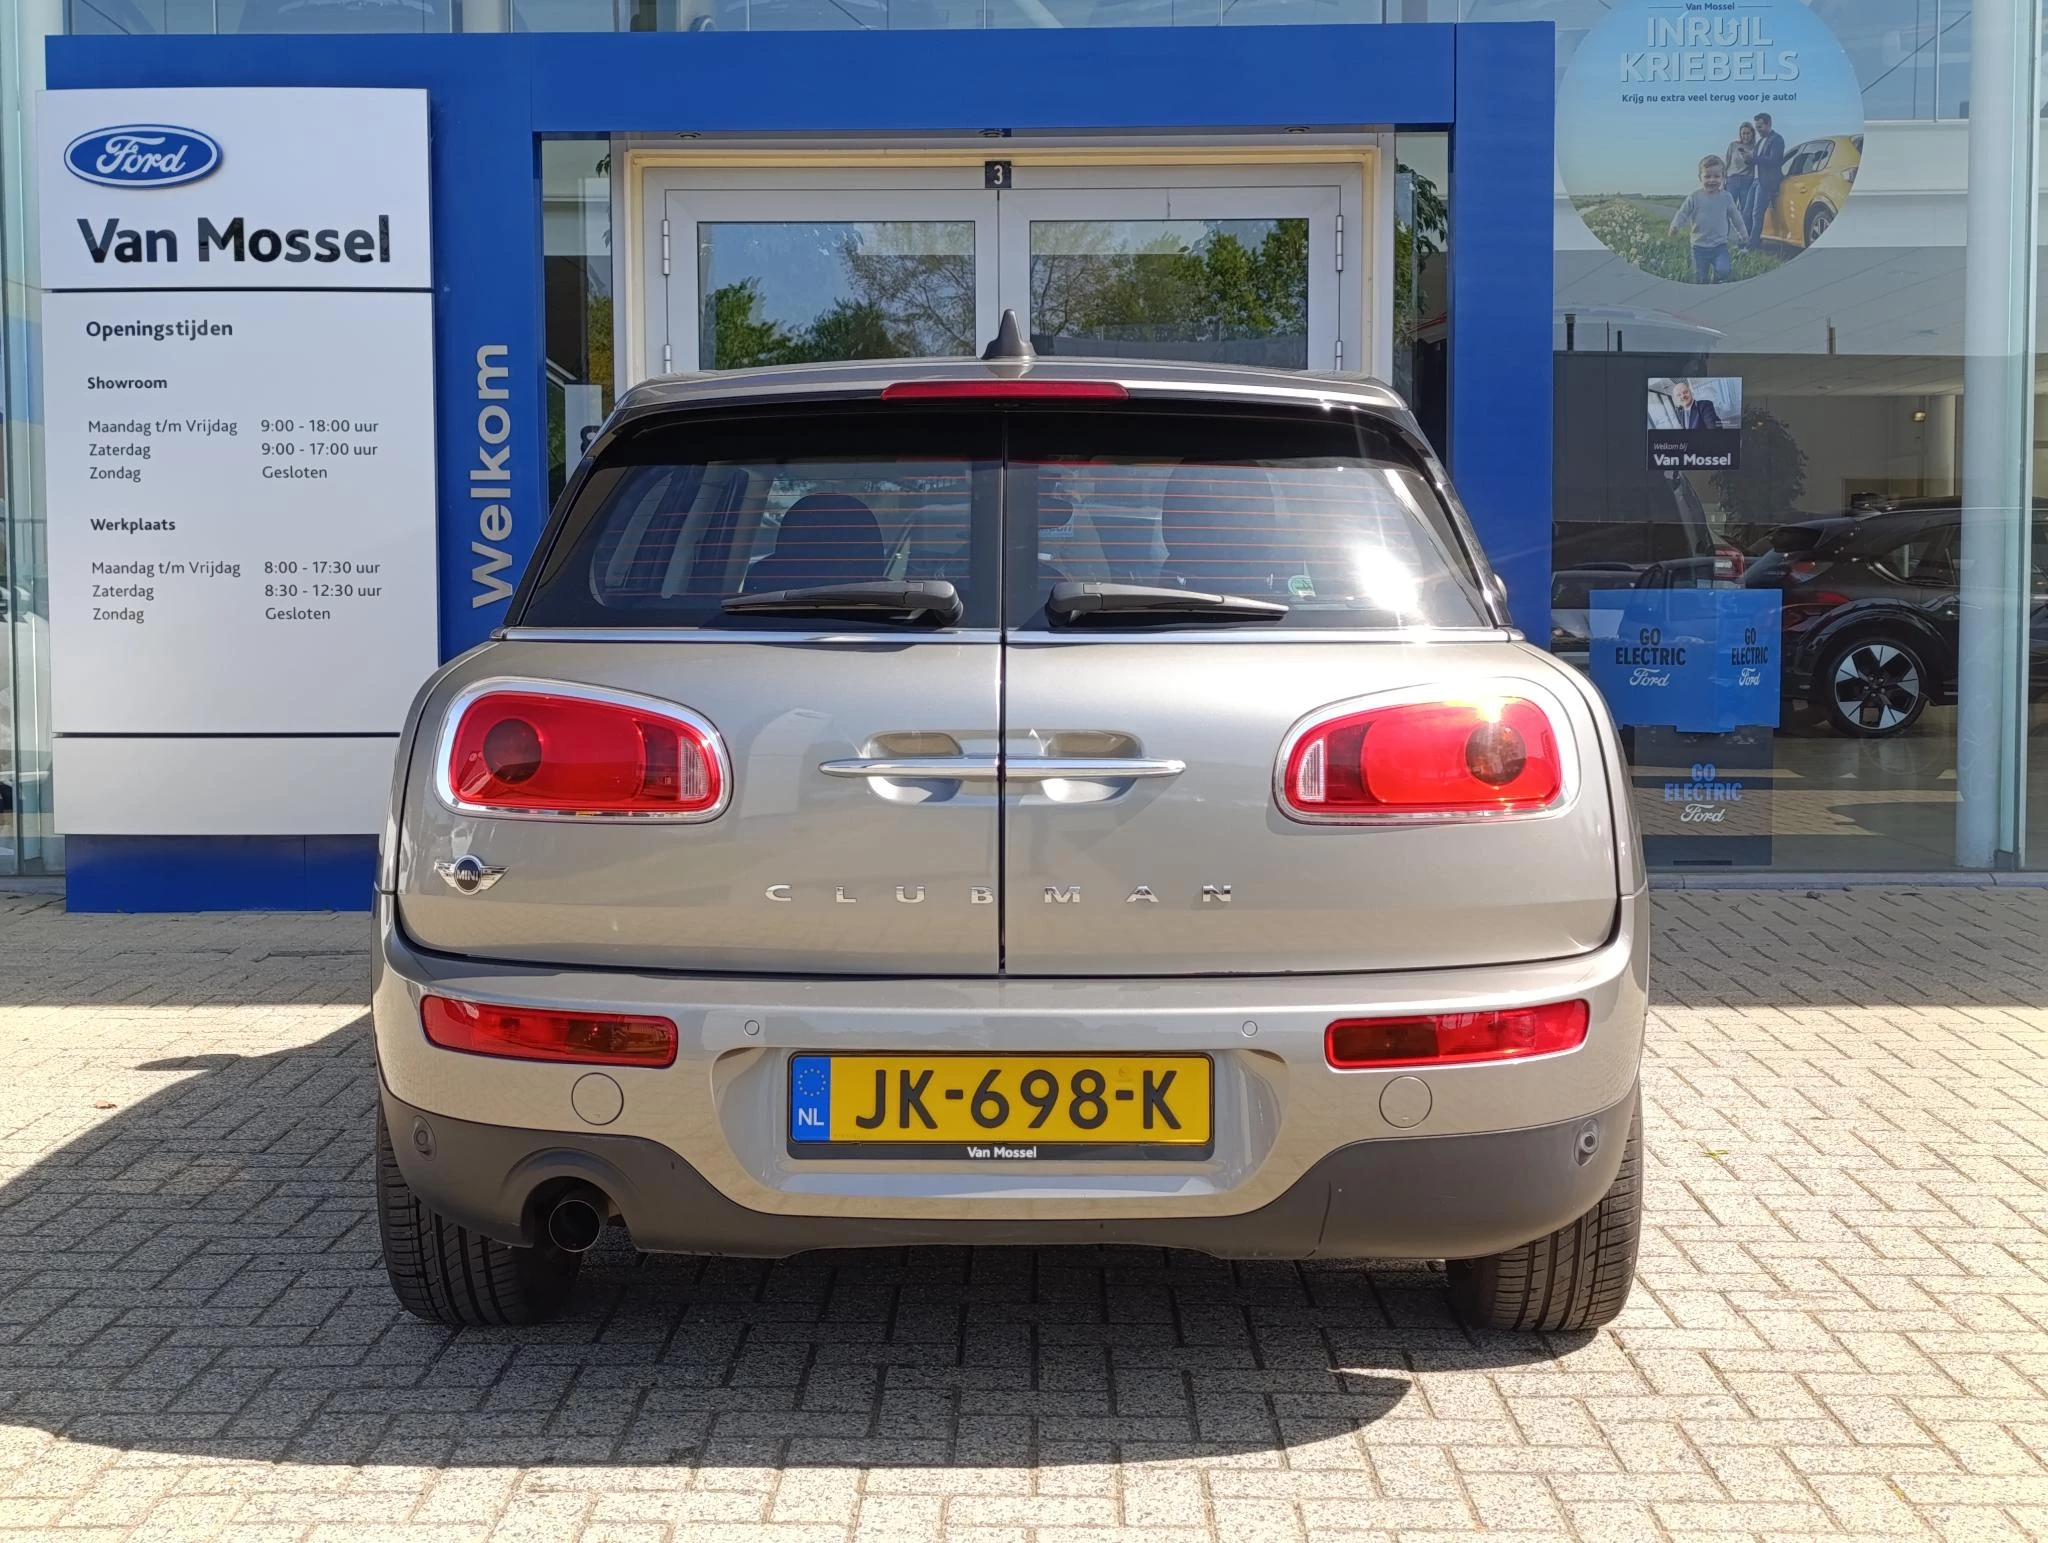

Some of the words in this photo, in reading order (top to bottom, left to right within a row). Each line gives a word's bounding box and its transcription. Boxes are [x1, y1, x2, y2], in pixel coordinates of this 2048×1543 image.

[1686, 2, 1702, 11] Van
[1704, 2, 1735, 11] Mossel
[1648, 16, 1774, 48] INRUIL
[1620, 51, 1800, 83] KRIEBELS
[1622, 94, 1644, 104] Krijg
[1660, 93, 1686, 102] extra
[1688, 93, 1708, 102] veel
[1710, 93, 1736, 103] terug
[1738, 93, 1760, 101] voor
[1761, 92, 1771, 103] je
[1773, 92, 1797, 101] auto!
[96, 135, 188, 175] Ford
[993, 164, 1003, 185] 3
[77, 217, 178, 264] Van
[198, 214, 391, 263] Mossel
[86, 320, 233, 341] Openingstijden
[87, 376, 168, 390] Showroom
[88, 420, 152, 436] Maandag
[155, 420, 182, 433] t/m
[186, 419, 238, 436] Vrijdag
[261, 419, 294, 433] 9:00
[309, 419, 350, 433] 18:00
[354, 422, 379, 433] uur
[89, 443, 151, 459] Zaterdag
[261, 442, 295, 456] 9:00
[310, 442, 349, 456] 17:00
[353, 445, 378, 456] uur
[1654, 443, 1678, 451] Welkom
[1653, 454, 1680, 467] Van
[1683, 453, 1732, 466] Mossel
[90, 466, 142, 482] Zondag
[262, 466, 328, 479] Gesloten
[470, 344, 513, 609] Welkom
[91, 518, 176, 534] Werkplaats
[91, 562, 155, 578] Maandag
[159, 561, 185, 575] t/m
[189, 561, 241, 578] Vrijdag
[264, 561, 298, 574] 8:00
[312, 561, 351, 574] 17:30
[356, 564, 381, 574] uur
[92, 585, 154, 600] Zaterdag
[265, 584, 298, 597] 8:30
[312, 584, 353, 597] 12:30
[357, 587, 382, 597] uur
[93, 608, 145, 624] Zondag
[265, 607, 331, 620] Gesloten
[1639, 628, 1661, 645] GO
[1744, 628, 1756, 645] GO
[1615, 648, 1686, 665] ELECTRIC
[1731, 647, 1768, 665] ELECTRIC
[1629, 668, 1670, 687] Ford
[1738, 668, 1760, 686] Ford
[1691, 763, 1716, 781] GO
[1664, 783, 1743, 801] ELECTRIC
[1680, 803, 1725, 822] Ford
[456, 869, 479, 881] MINI
[765, 884, 1232, 904] CLUBMAN
[855, 1069, 1182, 1130] JK-698-K
[798, 1107, 825, 1126] NL
[967, 1147, 990, 1158] Van
[993, 1146, 1037, 1158] Mossel
